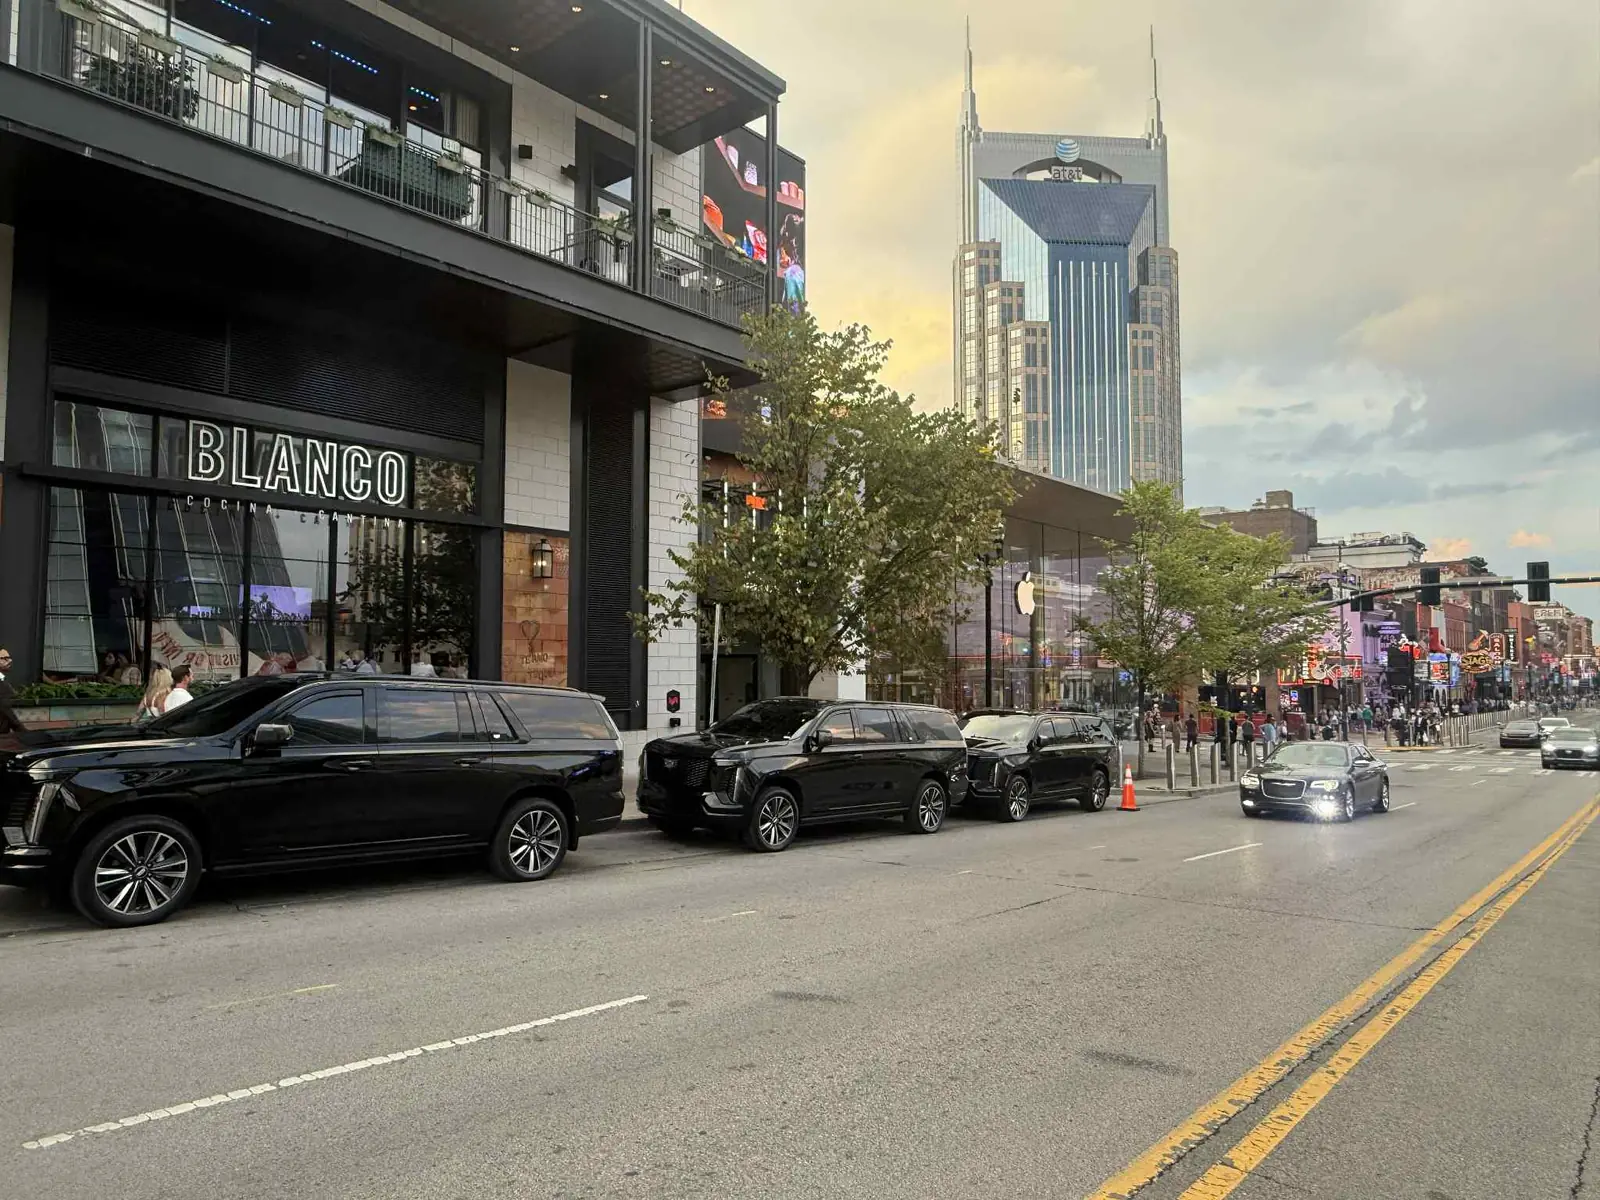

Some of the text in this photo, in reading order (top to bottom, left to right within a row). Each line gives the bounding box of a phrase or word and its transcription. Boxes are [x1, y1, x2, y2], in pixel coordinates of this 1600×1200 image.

[1053, 167, 1082, 180] at&t
[188, 420, 405, 505] BLANCO
[187, 495, 403, 528] COCINA CANTINA
